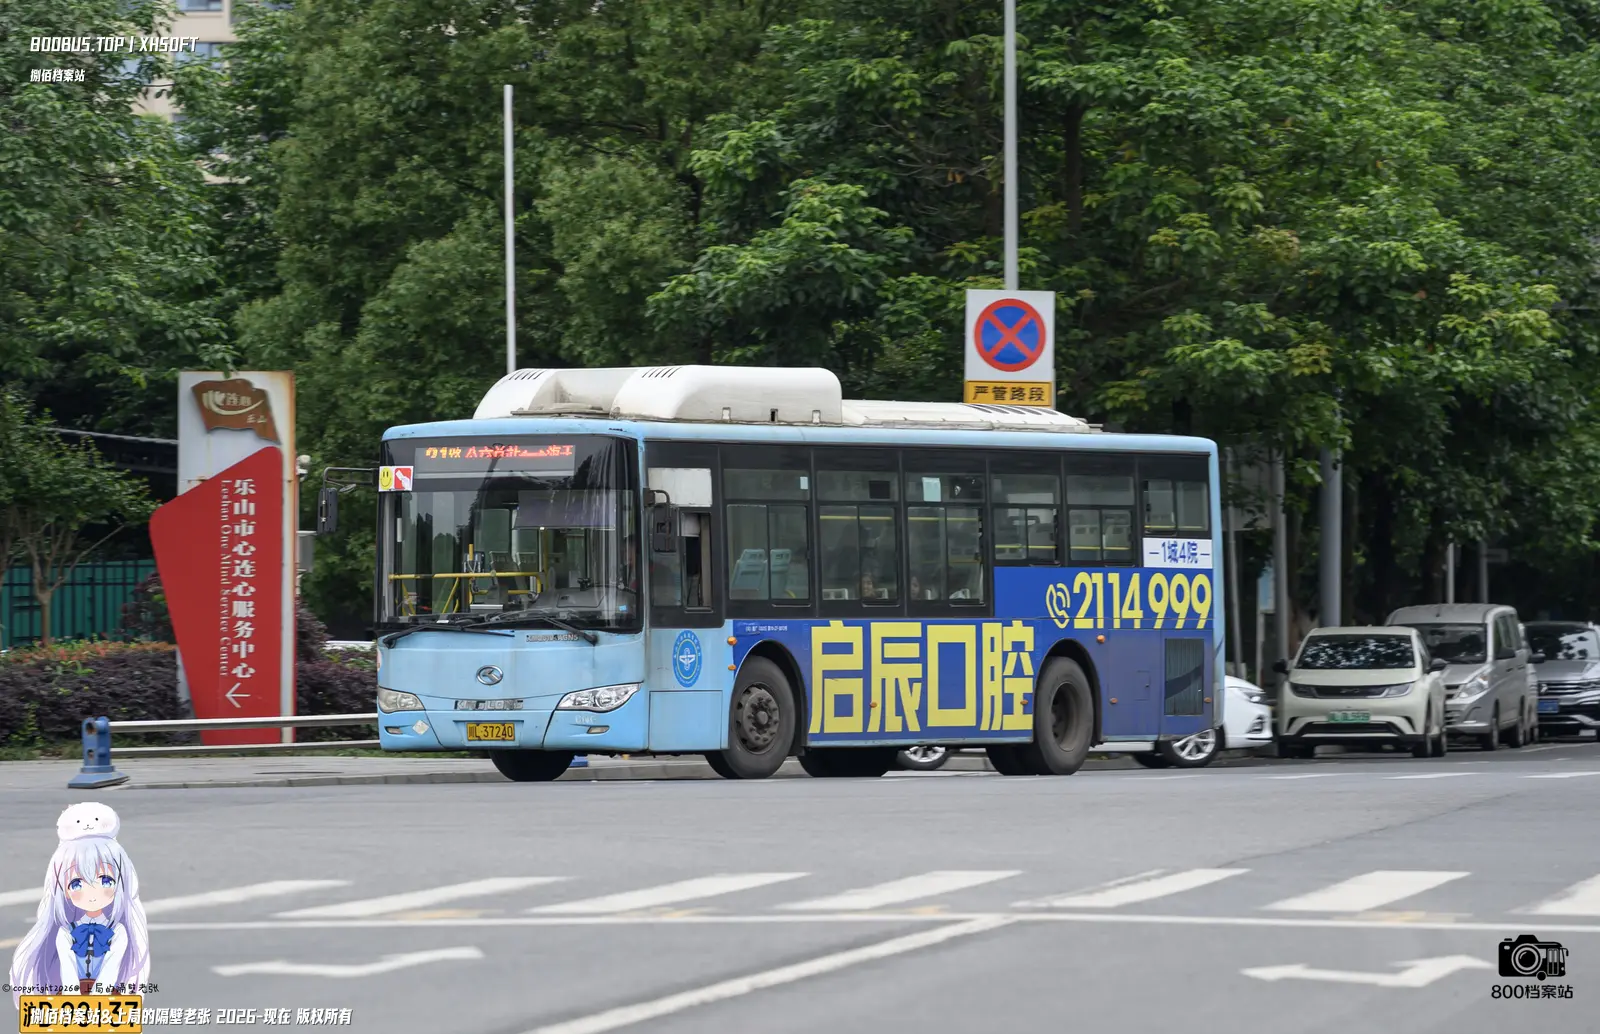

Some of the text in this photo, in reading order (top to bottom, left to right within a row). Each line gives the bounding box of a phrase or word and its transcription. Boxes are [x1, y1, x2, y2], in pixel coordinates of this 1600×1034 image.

[973, 386, 1044, 401] 严管路段
[220, 525, 232, 549] One
[220, 553, 232, 585] Mind
[232, 478, 256, 678] 乐山市心连心服务中心
[220, 588, 232, 632] Service
[1074, 571, 1212, 629] 2114 999
[220, 636, 232, 676] Center
[809, 620, 1035, 734] 启辰口腔
[454, 699, 524, 710] KING LONG
